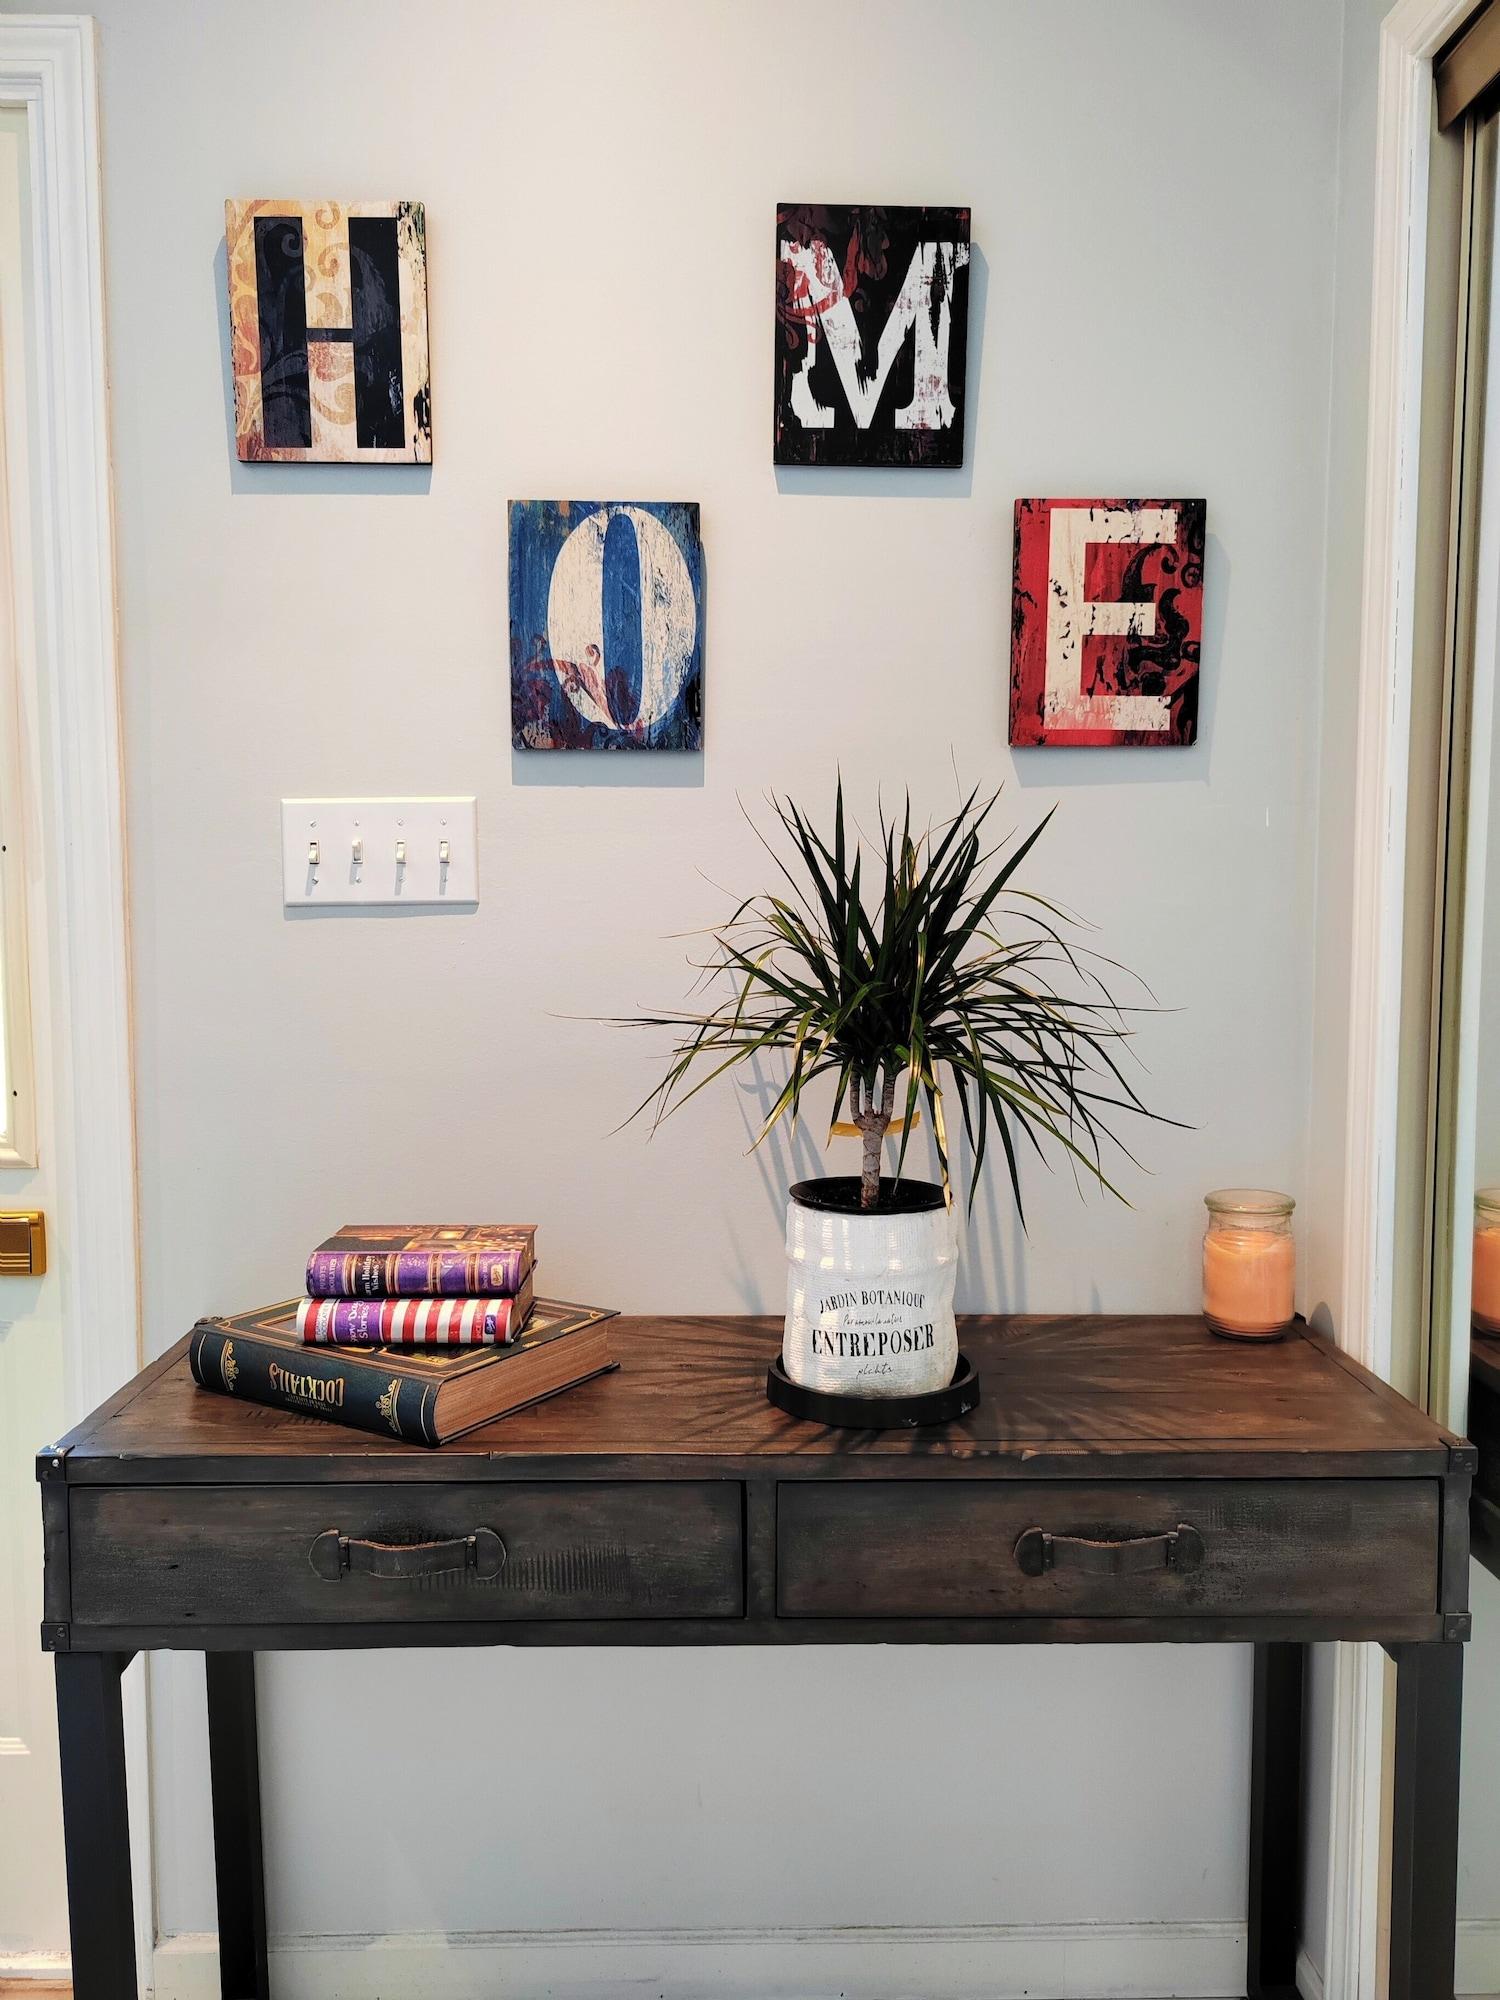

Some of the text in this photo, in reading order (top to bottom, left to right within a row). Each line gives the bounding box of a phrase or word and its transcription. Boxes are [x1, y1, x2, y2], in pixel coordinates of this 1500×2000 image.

[254, 216, 406, 449] H
[781, 240, 971, 430] M
[547, 505, 697, 731] O
[1043, 508, 1178, 731] E
[347, 1300, 364, 1320] Day
[356, 1304, 370, 1339] Stories
[820, 1292, 857, 1314] JARDIN
[812, 1323, 935, 1357] ENTREPOSER
[268, 1362, 345, 1407] COCKTAILS
